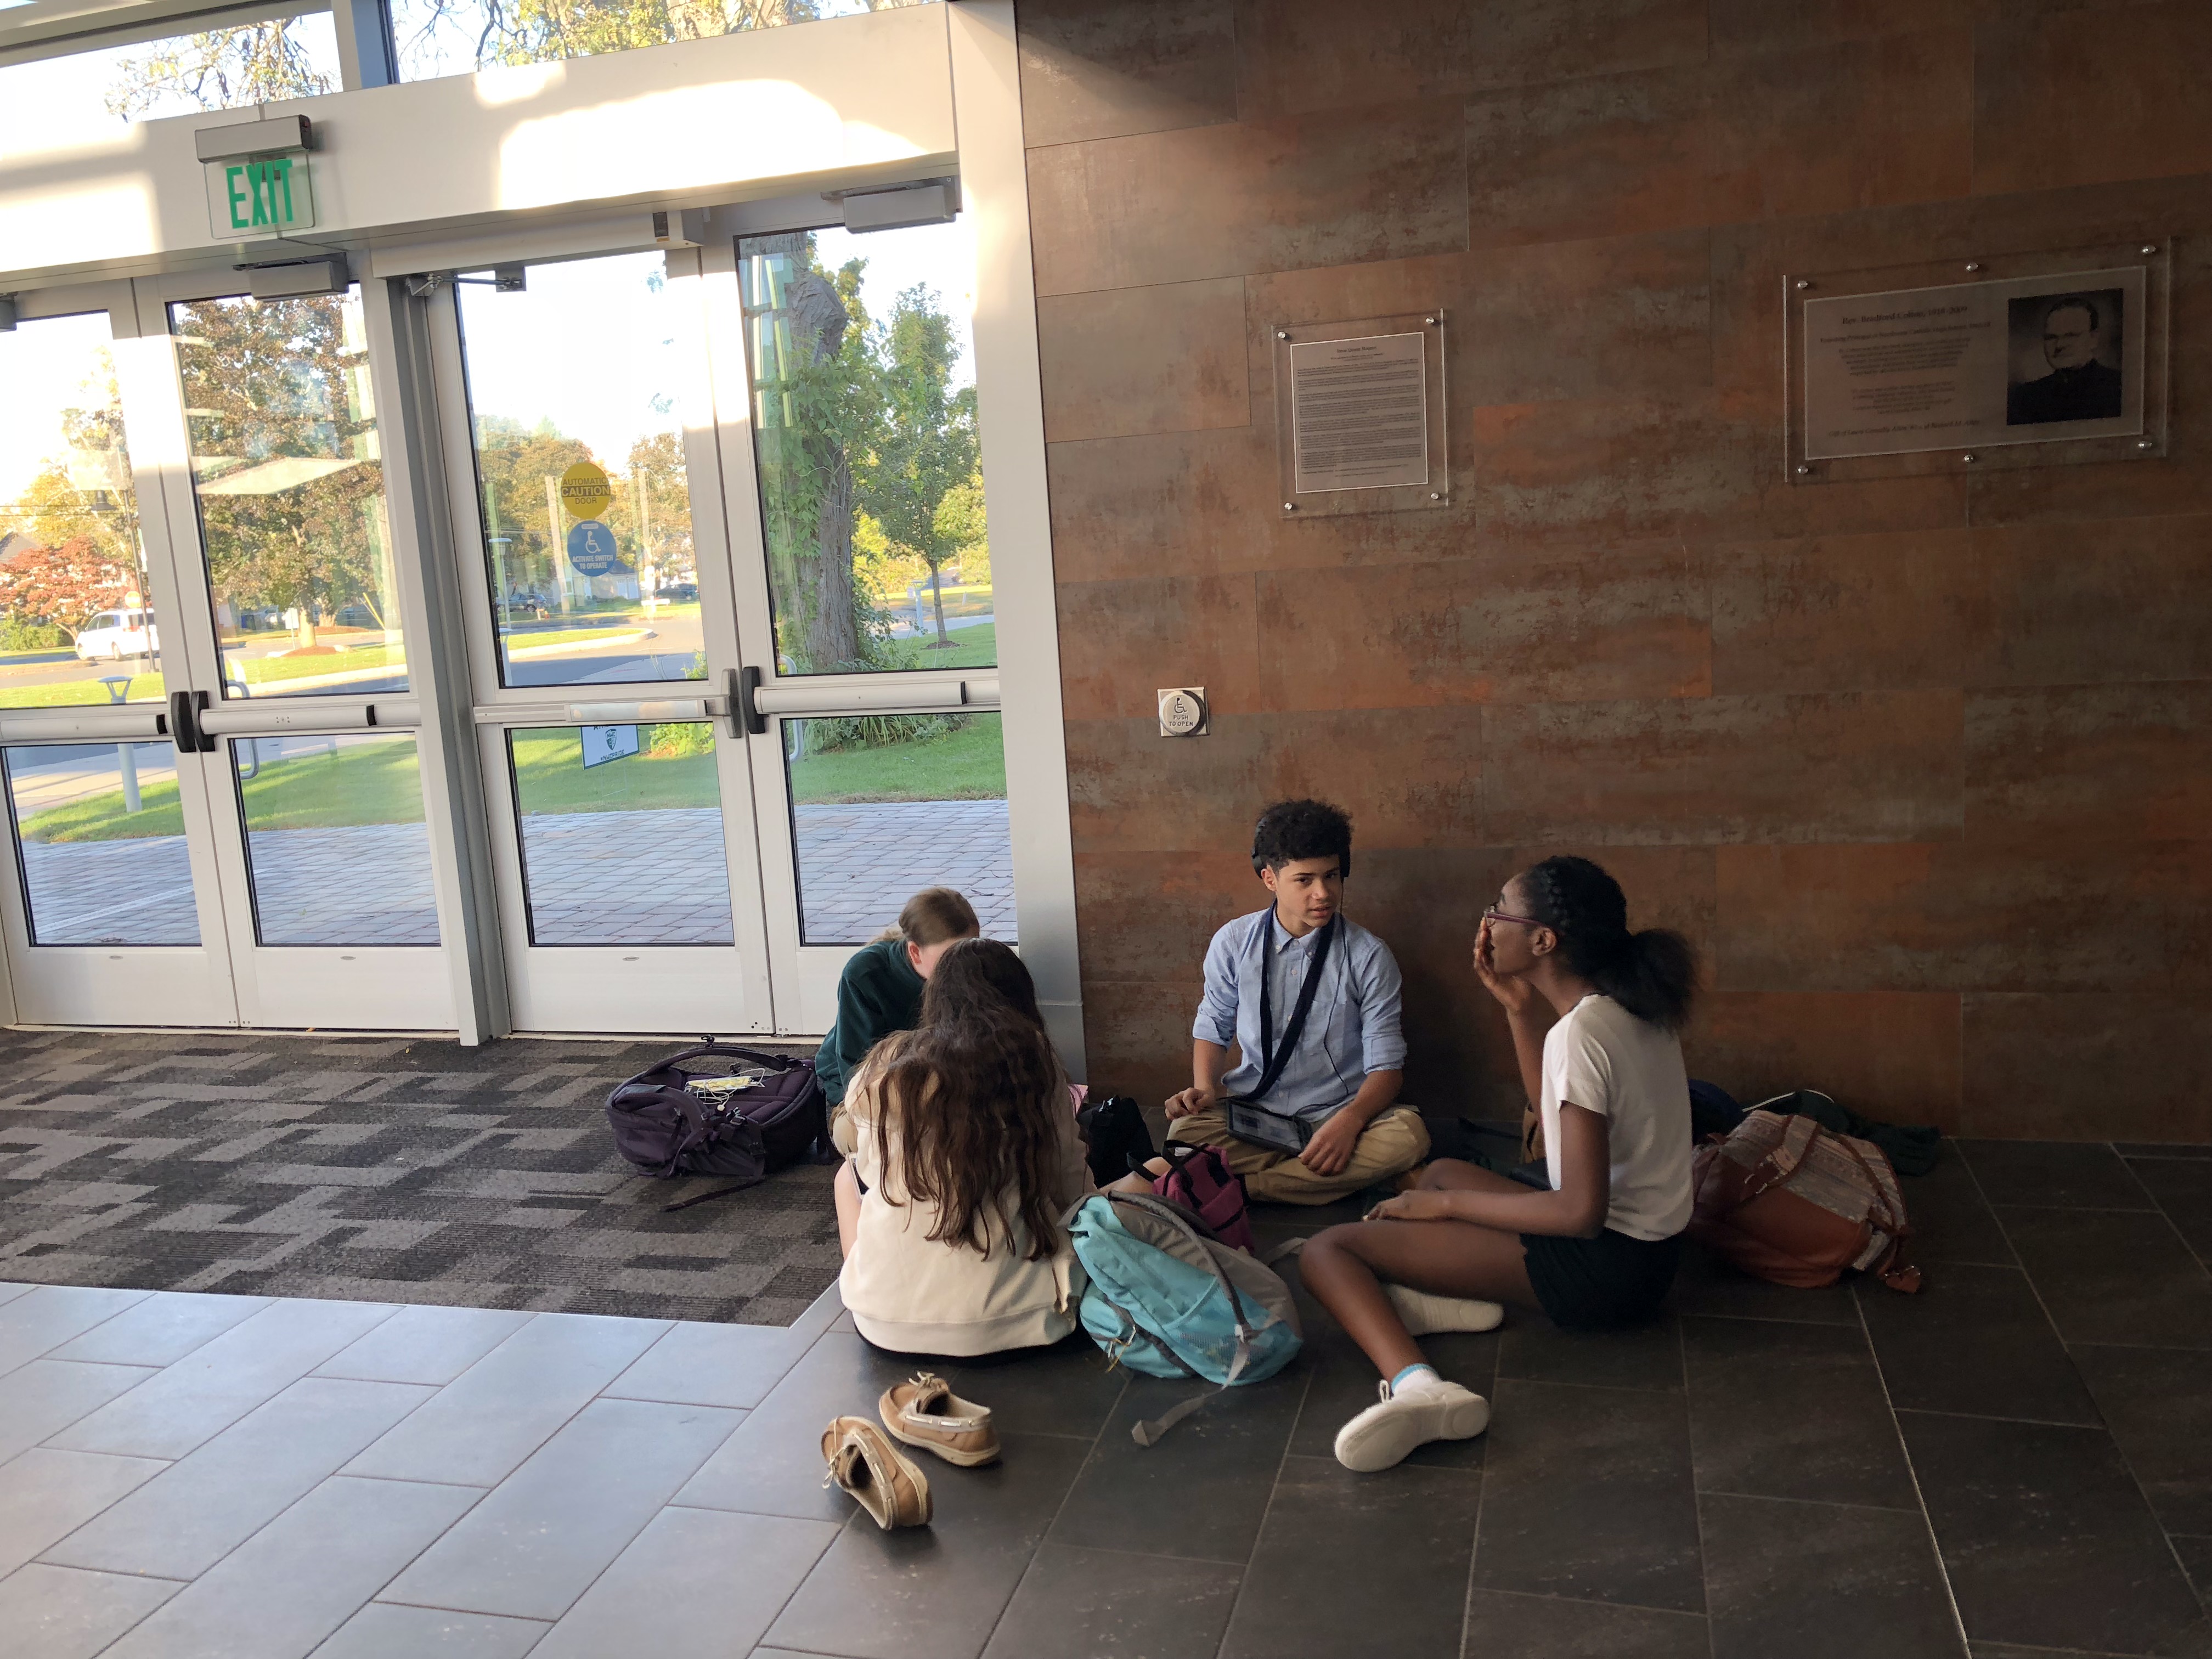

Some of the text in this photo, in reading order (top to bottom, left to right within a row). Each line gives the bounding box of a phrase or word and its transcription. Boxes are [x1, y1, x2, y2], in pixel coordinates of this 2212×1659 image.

[226, 159, 293, 229] EXIT
[1861, 313, 1895, 323] Bradford
[563, 477, 607, 486] AUTOMATIC
[561, 486, 610, 496] CAUTION
